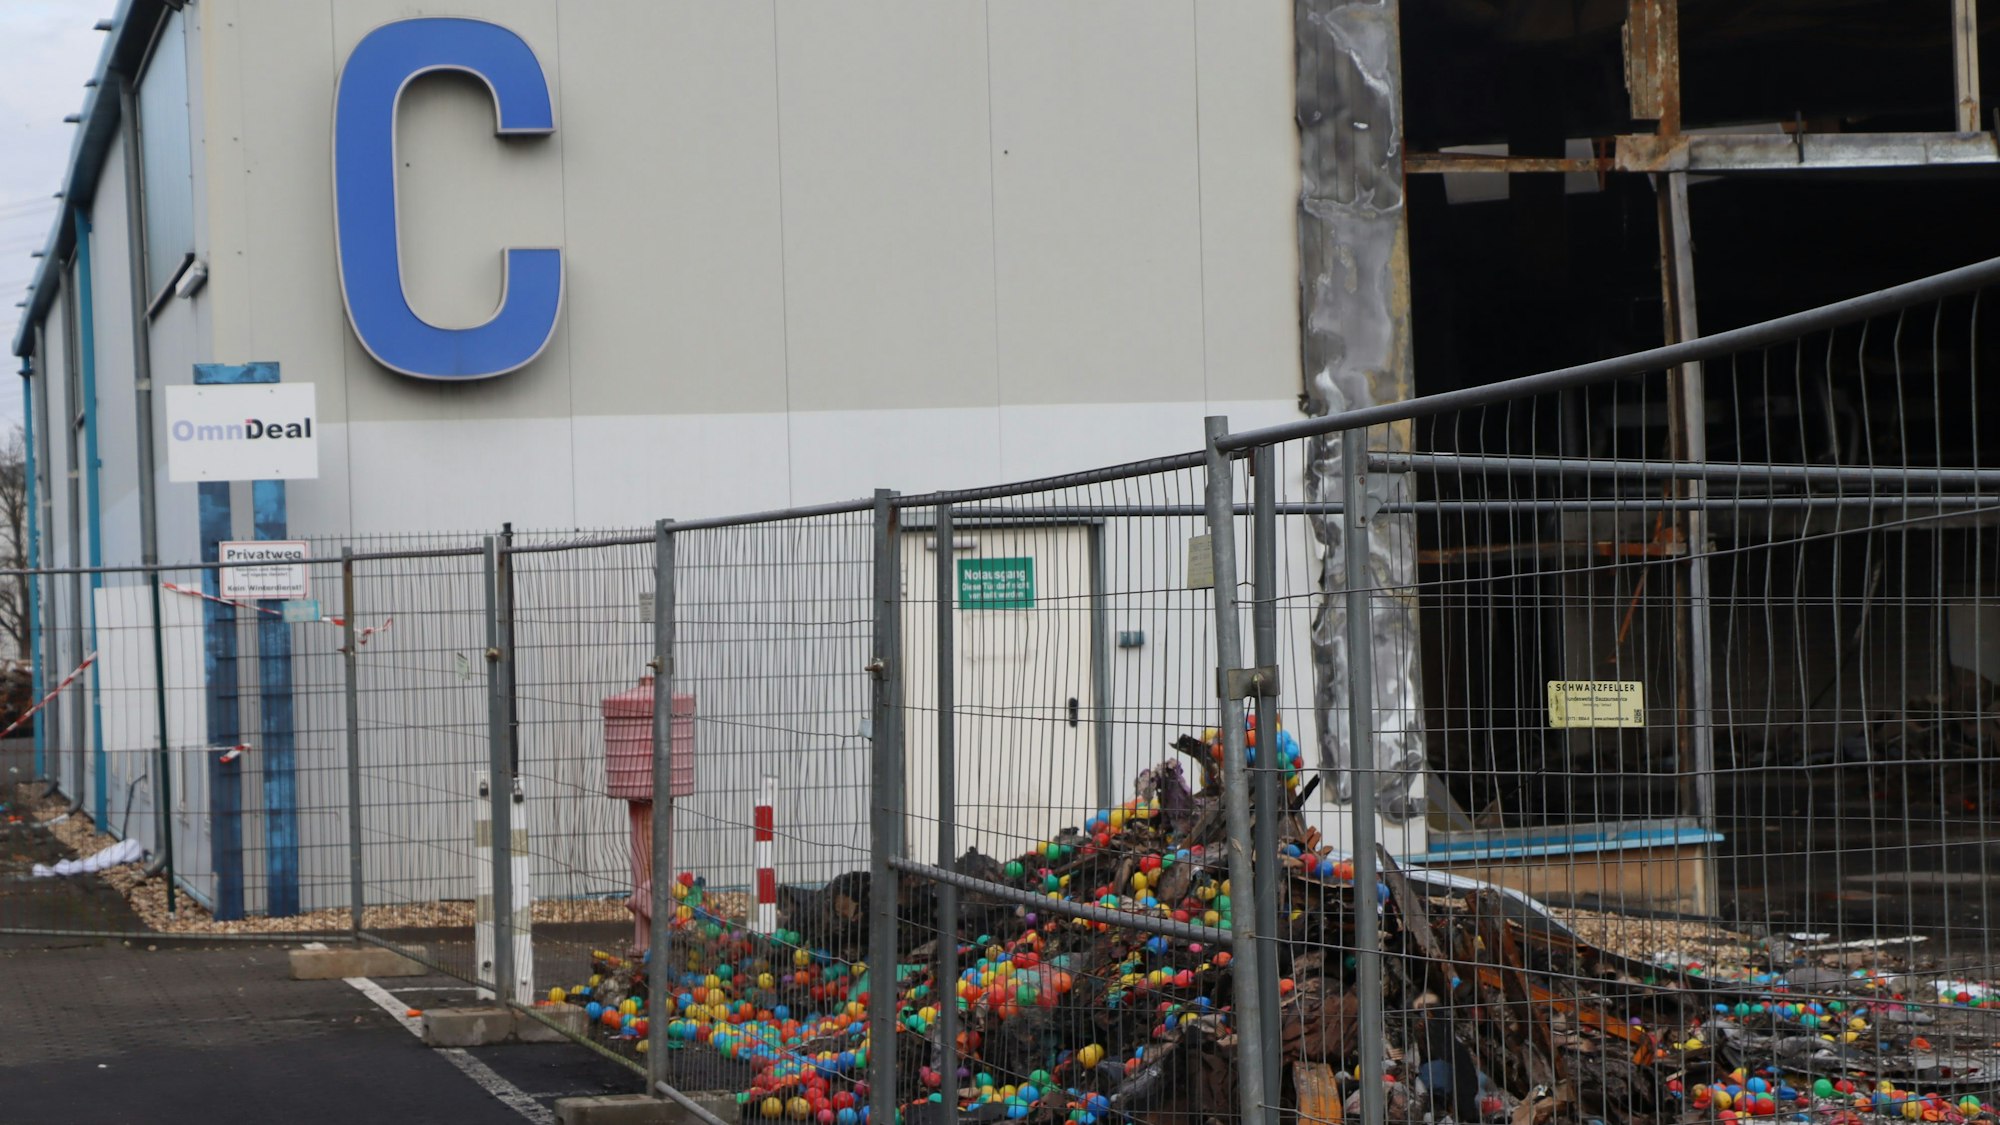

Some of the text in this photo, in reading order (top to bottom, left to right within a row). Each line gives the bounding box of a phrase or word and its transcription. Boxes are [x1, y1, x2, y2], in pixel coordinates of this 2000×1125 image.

[332, 16, 565, 381] C
[226, 548, 302, 561] Privatweg
[963, 568, 1026, 582] Notausgang
[227, 584, 245, 592] Kein
[982, 581, 995, 590] Tü
[968, 591, 997, 599] vertellt
[1555, 683, 1635, 692] SCHWARZFELLER
